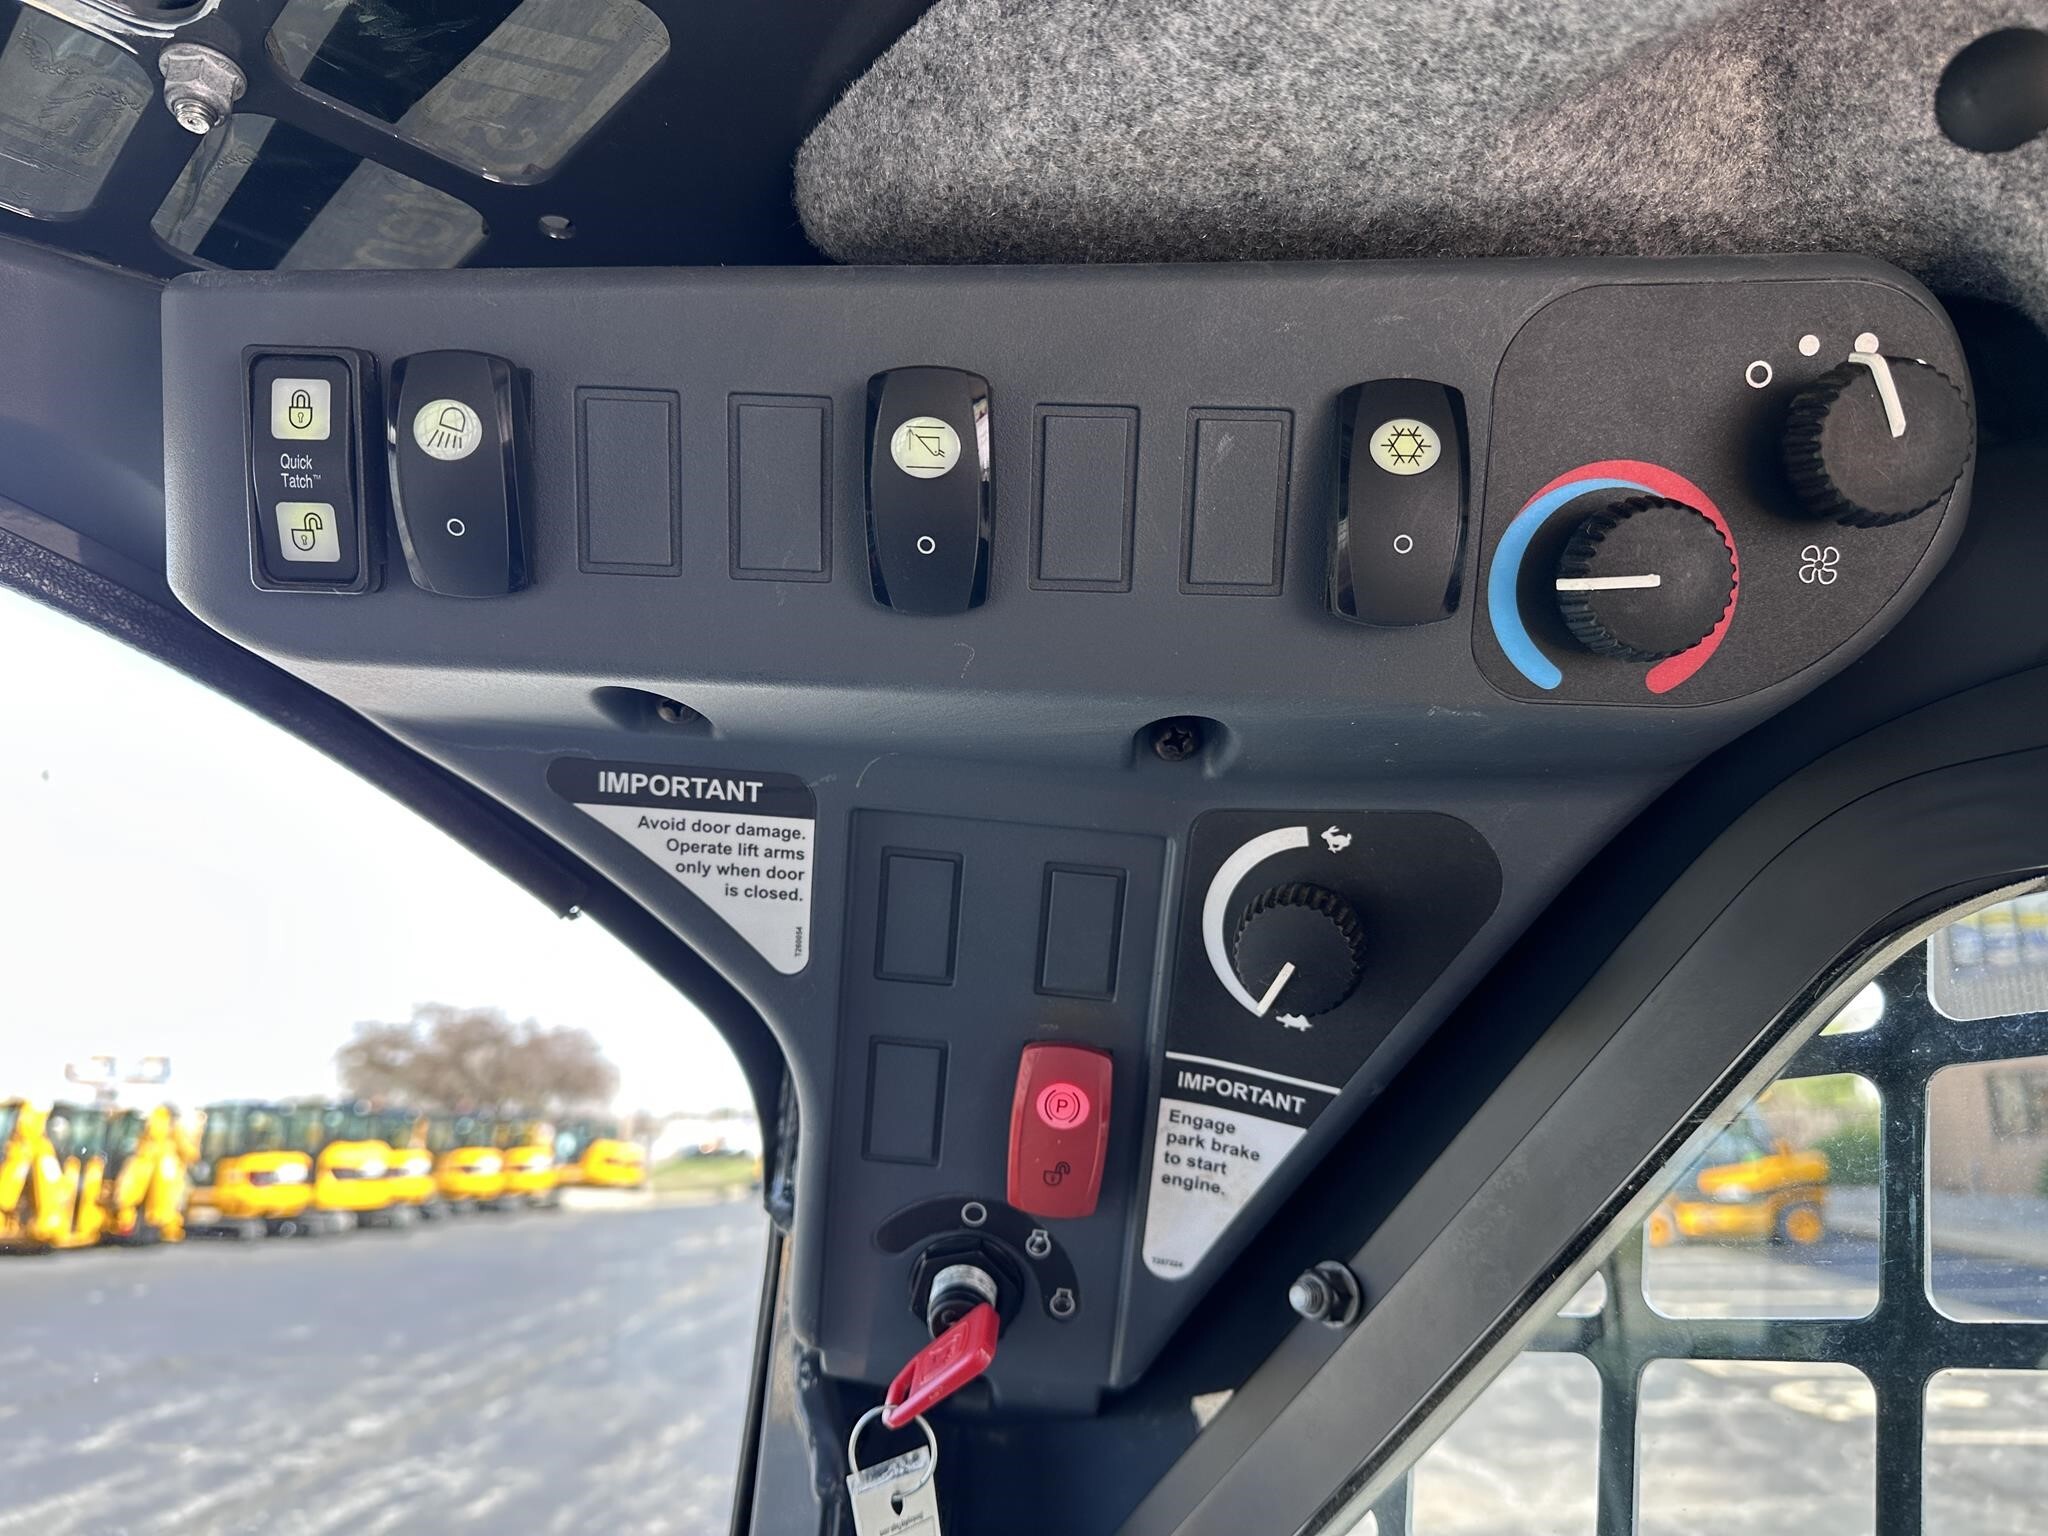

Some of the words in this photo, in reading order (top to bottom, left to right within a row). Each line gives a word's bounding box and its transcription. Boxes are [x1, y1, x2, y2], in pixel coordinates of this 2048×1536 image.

[280, 453, 313, 470] Quick
[598, 770, 763, 803] IMPORTANT
[637, 815, 686, 832] Avoid
[691, 819, 731, 835] door
[735, 820, 806, 842] damage.
[666, 838, 732, 856] Operate
[738, 843, 759, 858] lift
[763, 847, 805, 861] arms
[675, 861, 711, 878] only
[716, 862, 760, 878] when
[766, 865, 805, 881] door
[724, 883, 738, 897] is
[744, 884, 803, 902] closed.
[1177, 1071, 1306, 1115] IMPORTANT
[1056, 1098, 1069, 1113] P
[1168, 1109, 1236, 1135] Engage
[1165, 1131, 1205, 1149] park
[1211, 1140, 1260, 1161] brake
[1164, 1152, 1181, 1166] to
[1186, 1155, 1227, 1175] start
[1161, 1171, 1225, 1195] engine.
